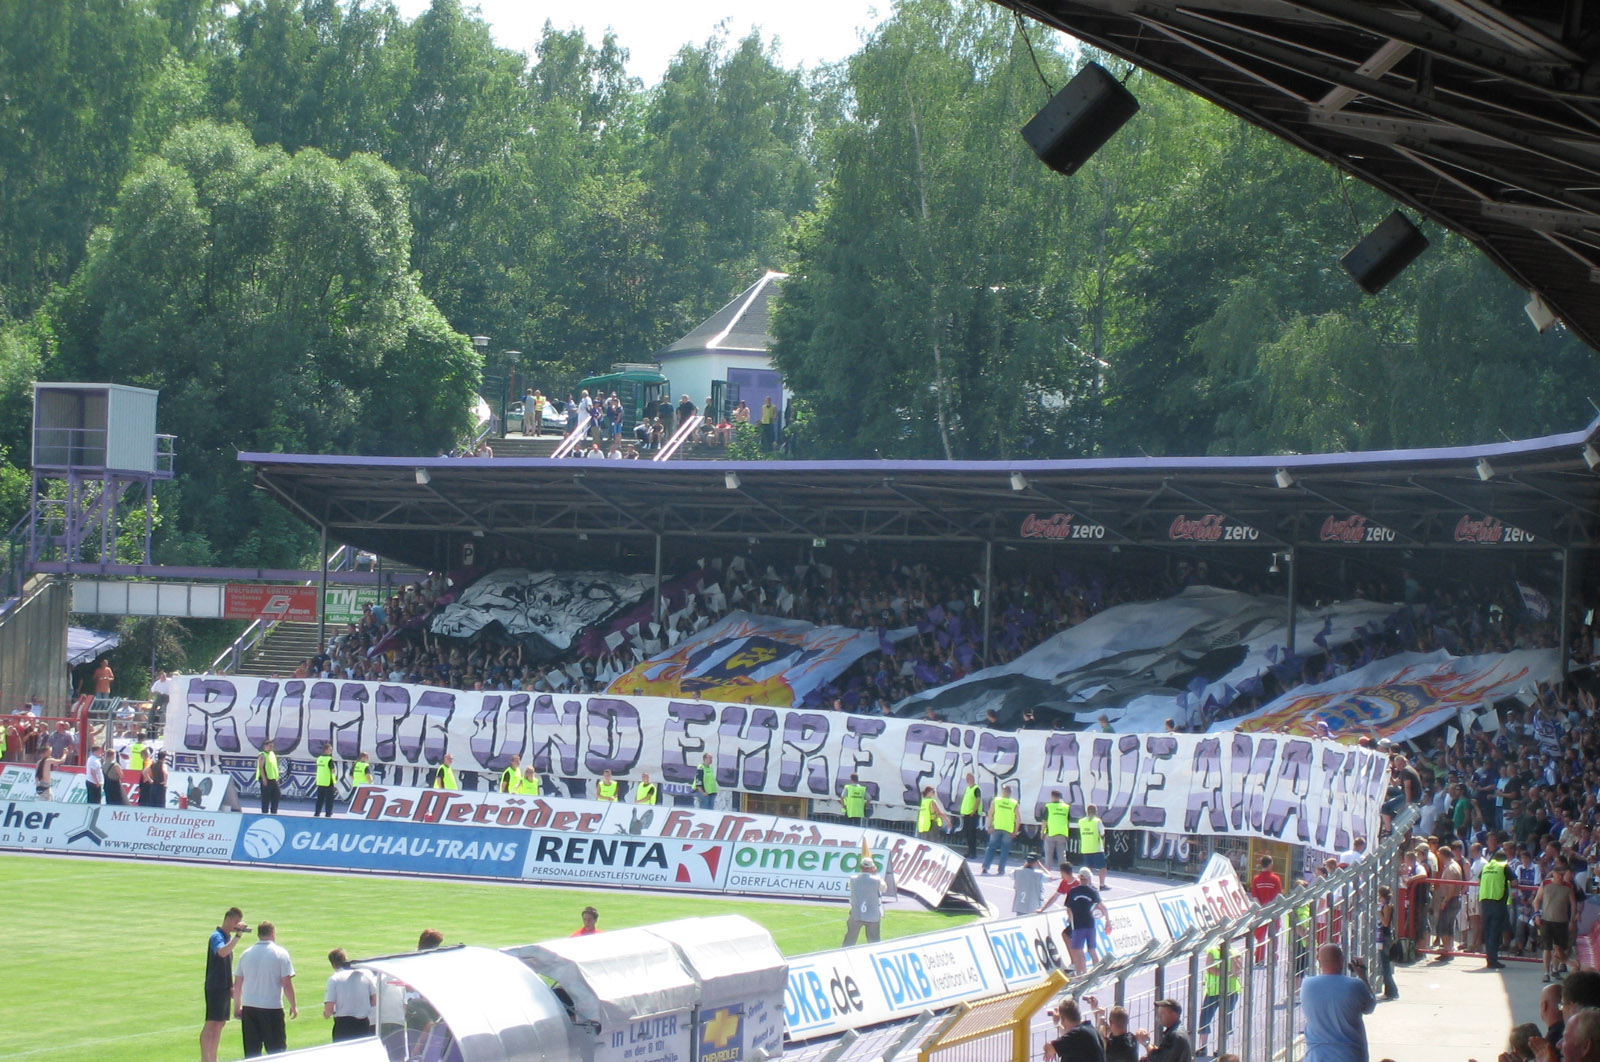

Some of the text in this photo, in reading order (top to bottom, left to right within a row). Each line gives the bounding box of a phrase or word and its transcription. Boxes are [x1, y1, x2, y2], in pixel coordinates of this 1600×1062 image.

[1020, 513, 1105, 539] Coca-Cola zero
[1169, 514, 1259, 541] Coca-Cola zero
[1320, 514, 1396, 542] Coca-Cola zero
[1454, 514, 1502, 542] Coca-Cola
[183, 677, 456, 765] RUHM
[470, 693, 642, 777] UND
[661, 700, 886, 802] EHRE
[901, 723, 1020, 815] FÜR
[1034, 733, 1178, 828] AUE
[110, 810, 216, 829] Mit Verbindungen
[350, 786, 603, 834] Hasseröder
[146, 826, 177, 841] fängt
[178, 828, 206, 840] alles
[291, 830, 518, 863] GLAUCHAU-TRANS
[104, 838, 229, 857] www.preschergroup.com
[535, 835, 669, 870] RENTA
[532, 866, 668, 882] PERSONALDIENSTLEISTUNGEN
[730, 875, 815, 890] OBERFLÄCHEN
[818, 881, 841, 892] AUS
[860, 901, 868, 913] 6
[1020, 891, 1026, 903] 2
[991, 928, 1062, 979] DKB.de
[879, 951, 956, 1002] DKB Deutsche
[967, 966, 979, 984] AG
[784, 966, 864, 1027] DKB.de
[629, 1014, 677, 1044] LAUTER
[702, 1047, 740, 1062] CHEVROLET
